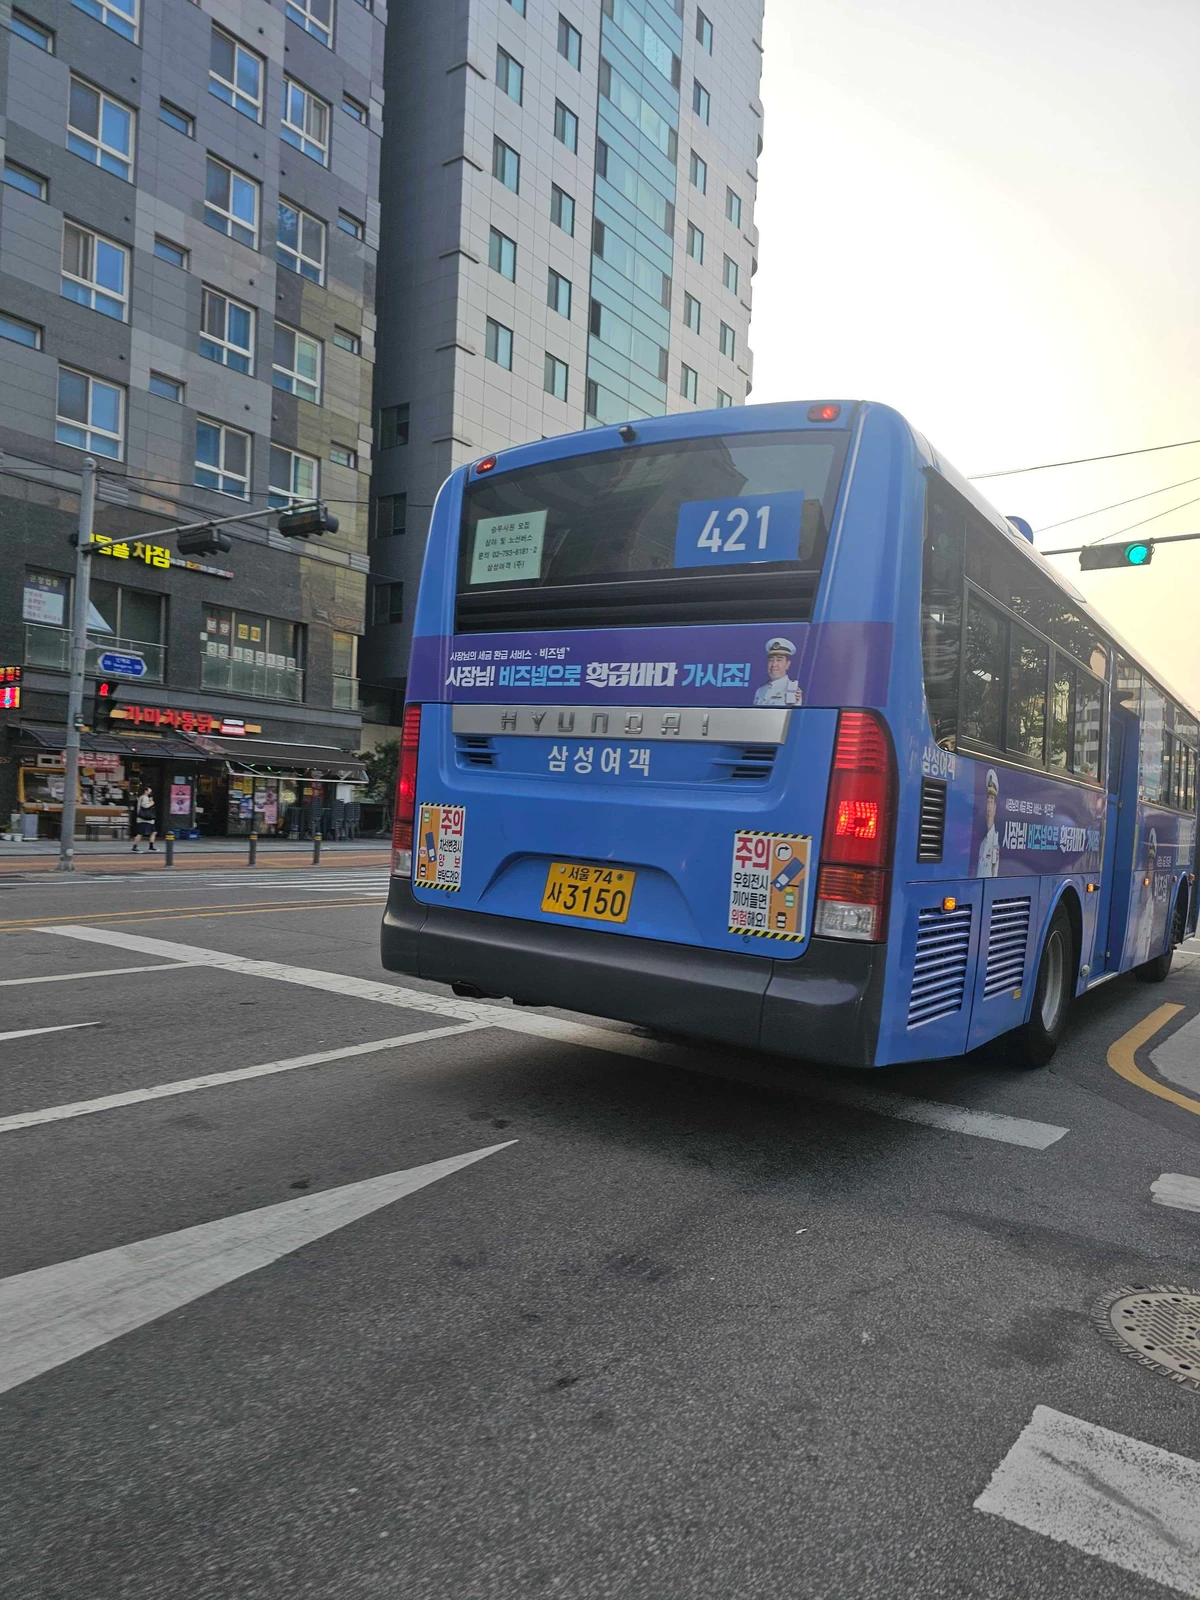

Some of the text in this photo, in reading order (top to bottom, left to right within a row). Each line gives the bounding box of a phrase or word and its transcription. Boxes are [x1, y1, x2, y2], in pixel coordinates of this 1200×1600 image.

[697, 505, 771, 553] 421
[450, 651, 476, 661] 사장님의
[478, 651, 492, 660] 세금
[493, 650, 508, 660] 환급
[510, 650, 532, 659] 서비스
[445, 661, 751, 688] 사장님! 비즈넵으로 환급바다 가시죠!
[500, 710, 710, 737] HYUNDAI
[548, 745, 651, 777] 삼성여객
[922, 745, 956, 781] 삼성여객
[441, 809, 464, 836] 주의
[439, 839, 462, 853] 차선변경시
[735, 837, 771, 870] 주의
[568, 867, 613, 885] 서울 74
[733, 872, 769, 891] 우회전시
[732, 891, 767, 909] 끼어들면
[731, 909, 766, 927] 위험해요!
[1093, 1319, 1187, 1383] METROPOLITAN
